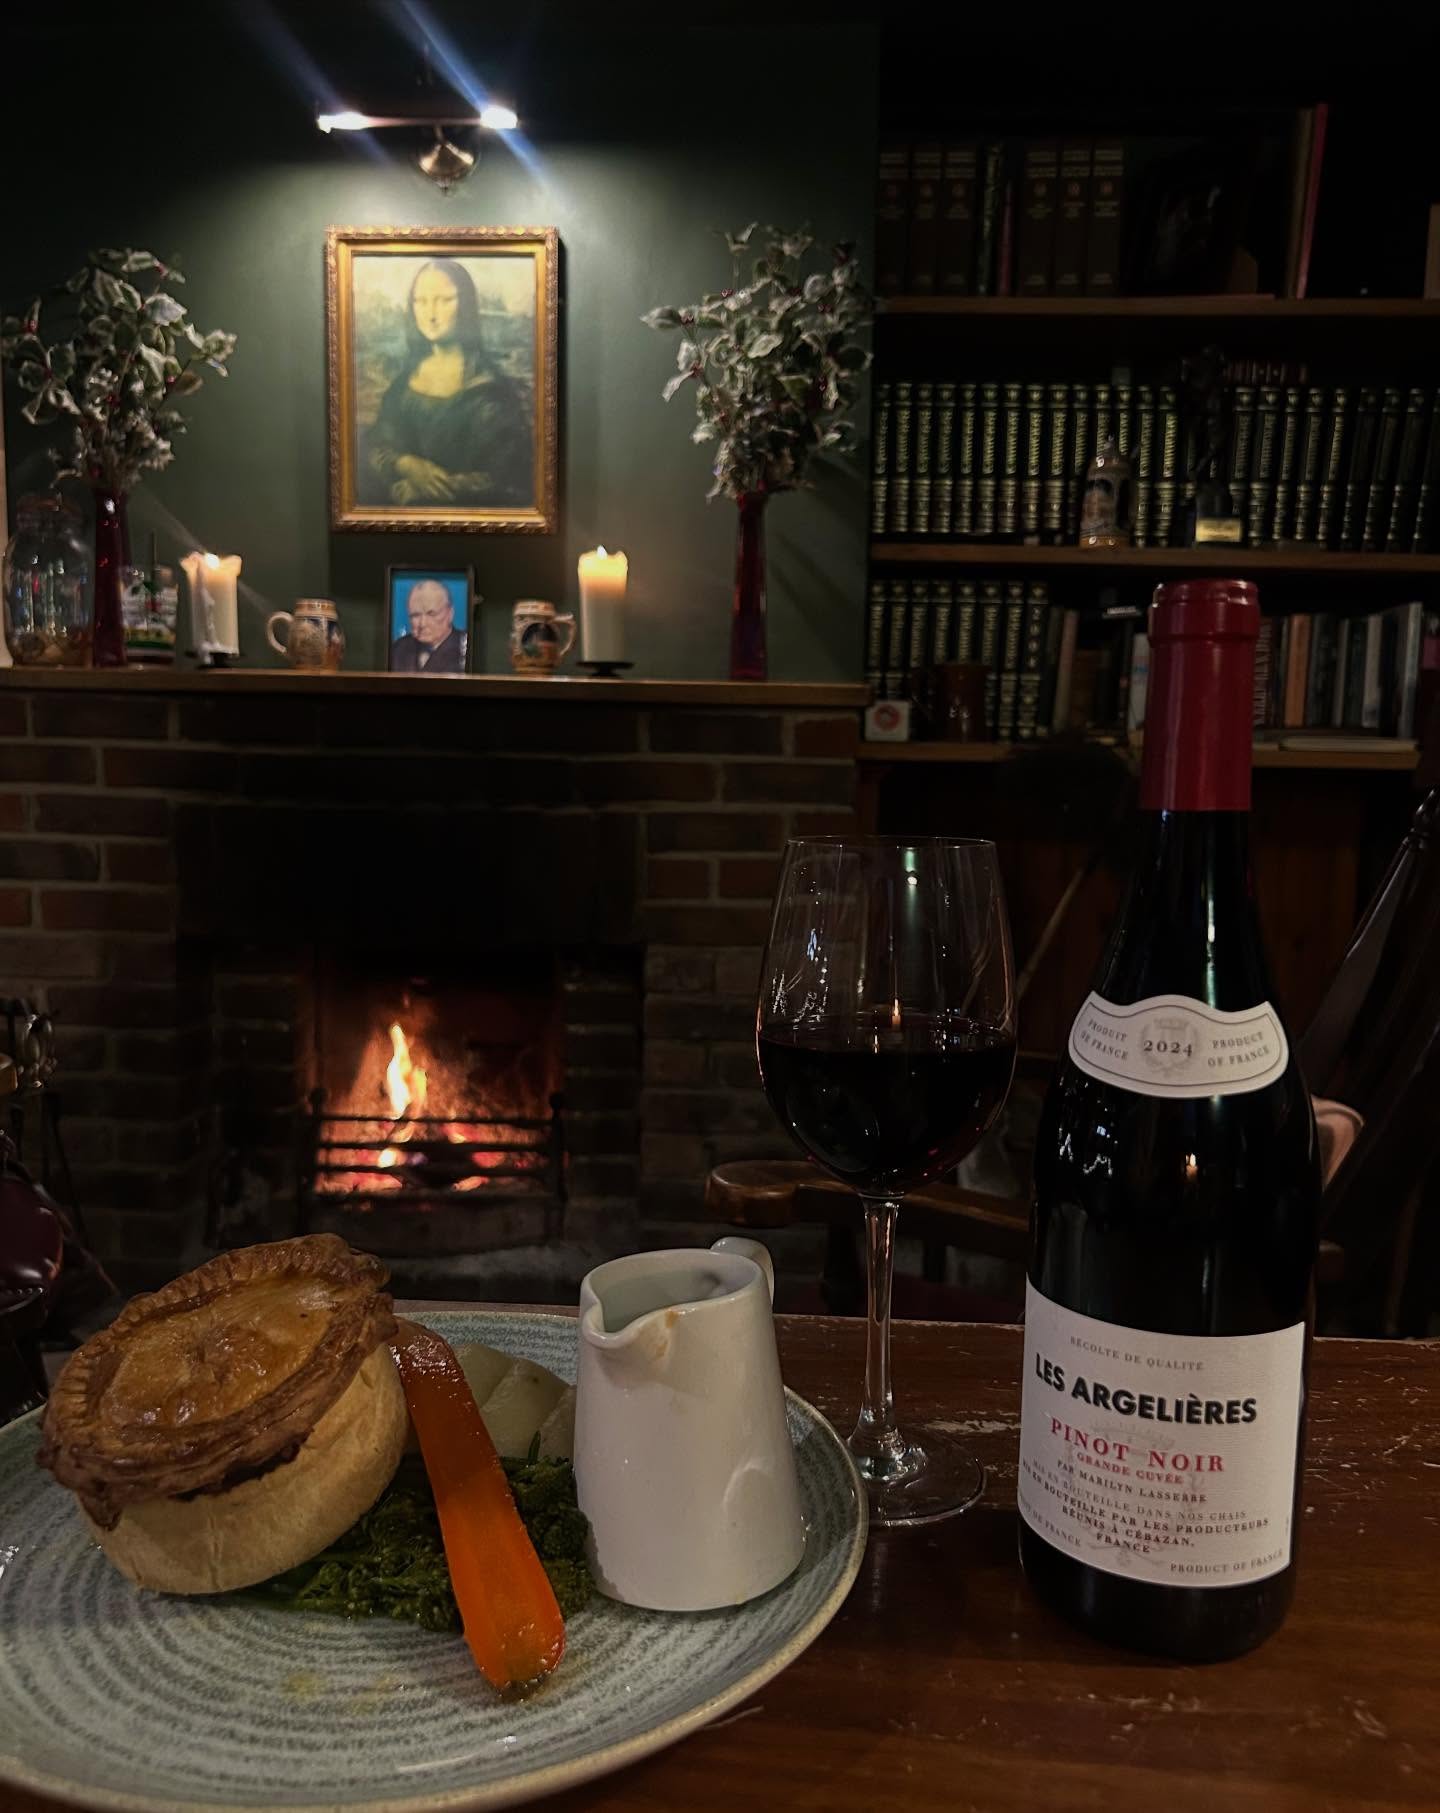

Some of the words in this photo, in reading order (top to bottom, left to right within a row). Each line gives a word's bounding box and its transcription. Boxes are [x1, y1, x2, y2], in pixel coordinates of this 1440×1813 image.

[1092, 1039, 1129, 1061] FRANCE
[1143, 1039, 1194, 1057] 2024
[1207, 1056, 1223, 1067] OF
[1229, 1046, 1270, 1066] FRANCE
[1212, 1031, 1264, 1049] PRODUCT
[1070, 1336, 1120, 1360] RÉCOLTE
[1124, 1353, 1142, 1364] DE
[1146, 1357, 1204, 1371] QUALITÉ
[1035, 1353, 1065, 1391] LES
[1072, 1376, 1258, 1424] ARGELIÈRES
[1050, 1417, 1130, 1461] PINOT
[1148, 1451, 1225, 1473] NOIR
[1057, 1460, 1075, 1475] PAR
[1079, 1471, 1133, 1494] MARILYN
[1139, 1488, 1208, 1503] LASSERRE
[1076, 1452, 1131, 1476] GRANDE
[1136, 1469, 1185, 1484] CUVÉE
[1044, 1481, 1106, 1517] BOUTEILLE
[1112, 1512, 1136, 1526] PAR
[1144, 1520, 1170, 1531] LES
[1176, 1518, 1269, 1533] PRODUCTEURS
[1063, 1481, 1130, 1511] BOUTEILLE
[1137, 1504, 1171, 1518] DANS
[1178, 1511, 1207, 1520] NOS
[1209, 1510, 1247, 1521] CHAIS
[1062, 1504, 1105, 1529] RÉUNIS
[1125, 1529, 1195, 1546] CÉBAZAN.
[1096, 1533, 1151, 1553] FRANCE
[1170, 1563, 1228, 1574] PRODUCT
[1233, 1562, 1246, 1571] OF
[1250, 1549, 1283, 1569] FRANCE
